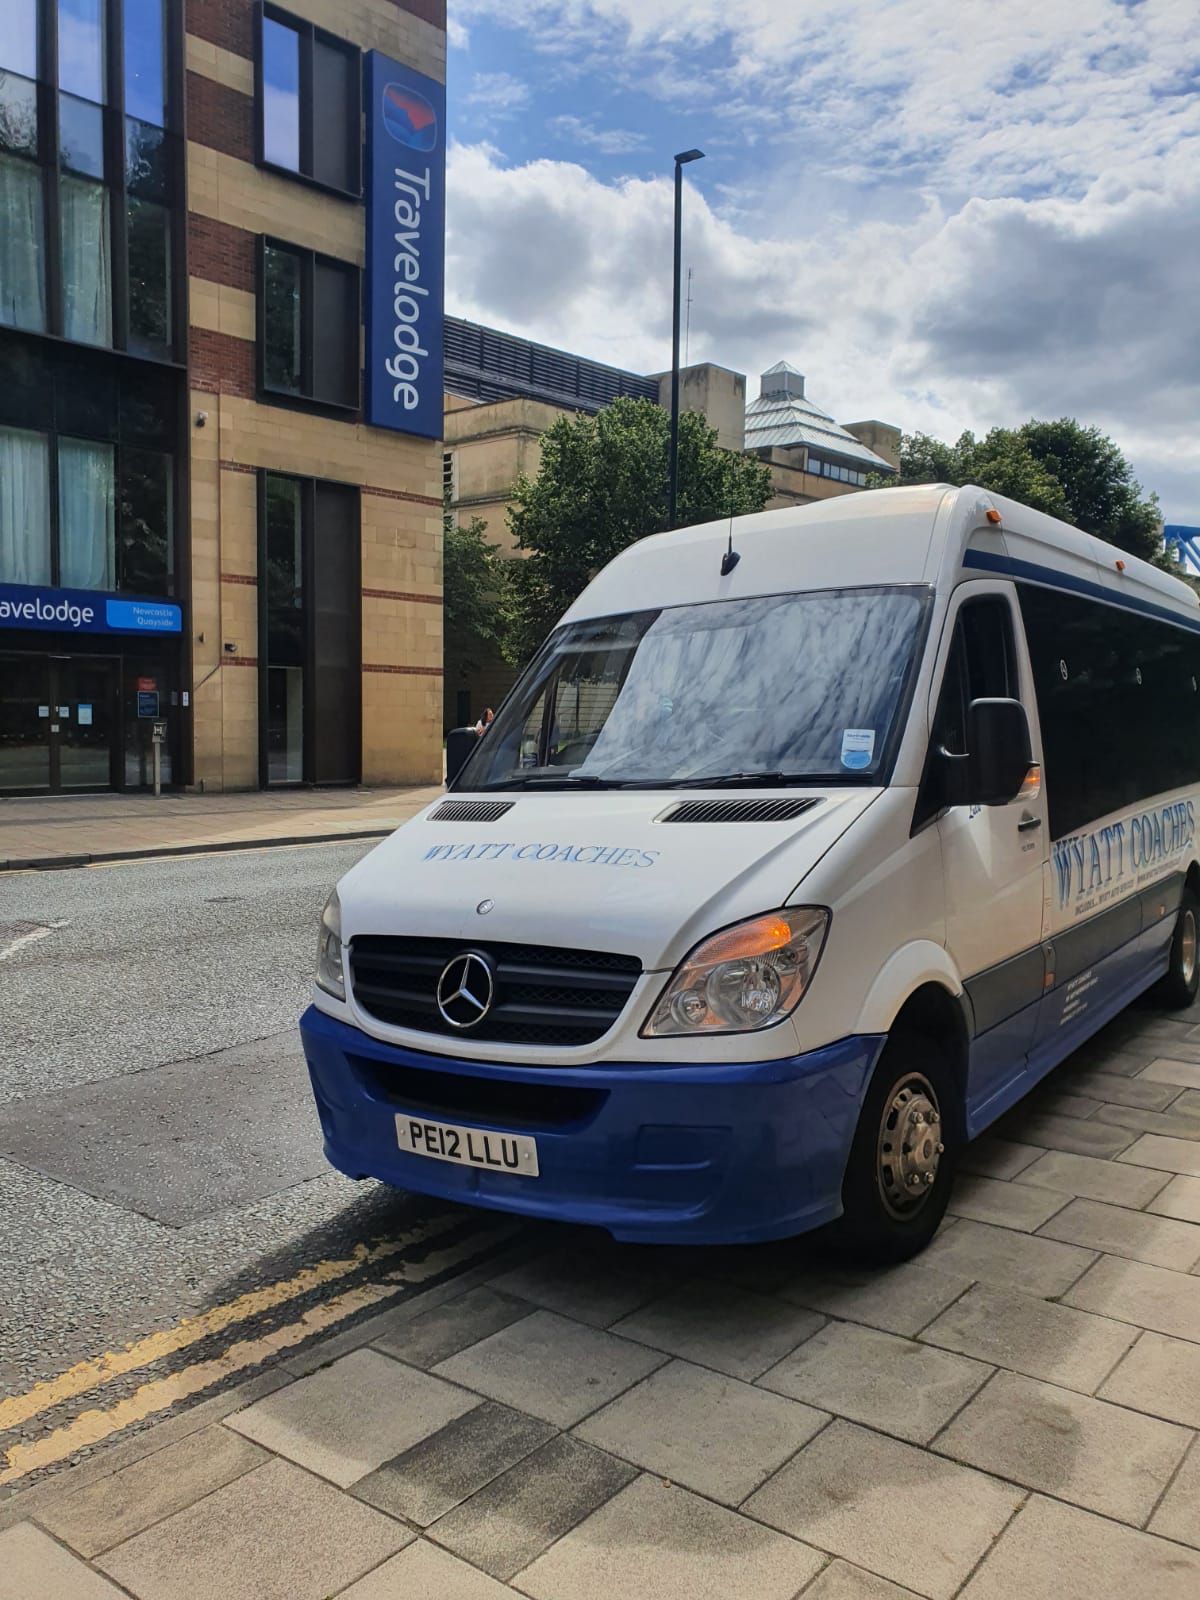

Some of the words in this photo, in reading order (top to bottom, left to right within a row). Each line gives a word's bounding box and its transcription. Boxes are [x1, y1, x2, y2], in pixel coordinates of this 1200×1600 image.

[385, 167, 430, 410] Travelodge
[0, 598, 94, 627] avelodge
[132, 606, 173, 617] Newcastle
[137, 617, 173, 627] Quayside
[421, 843, 516, 862] WYATT
[513, 843, 660, 868] COACHES
[1053, 821, 1125, 910] WYATT
[1130, 801, 1195, 873] COACHES
[409, 1121, 461, 1158] PE12
[467, 1133, 519, 1168] LLU
